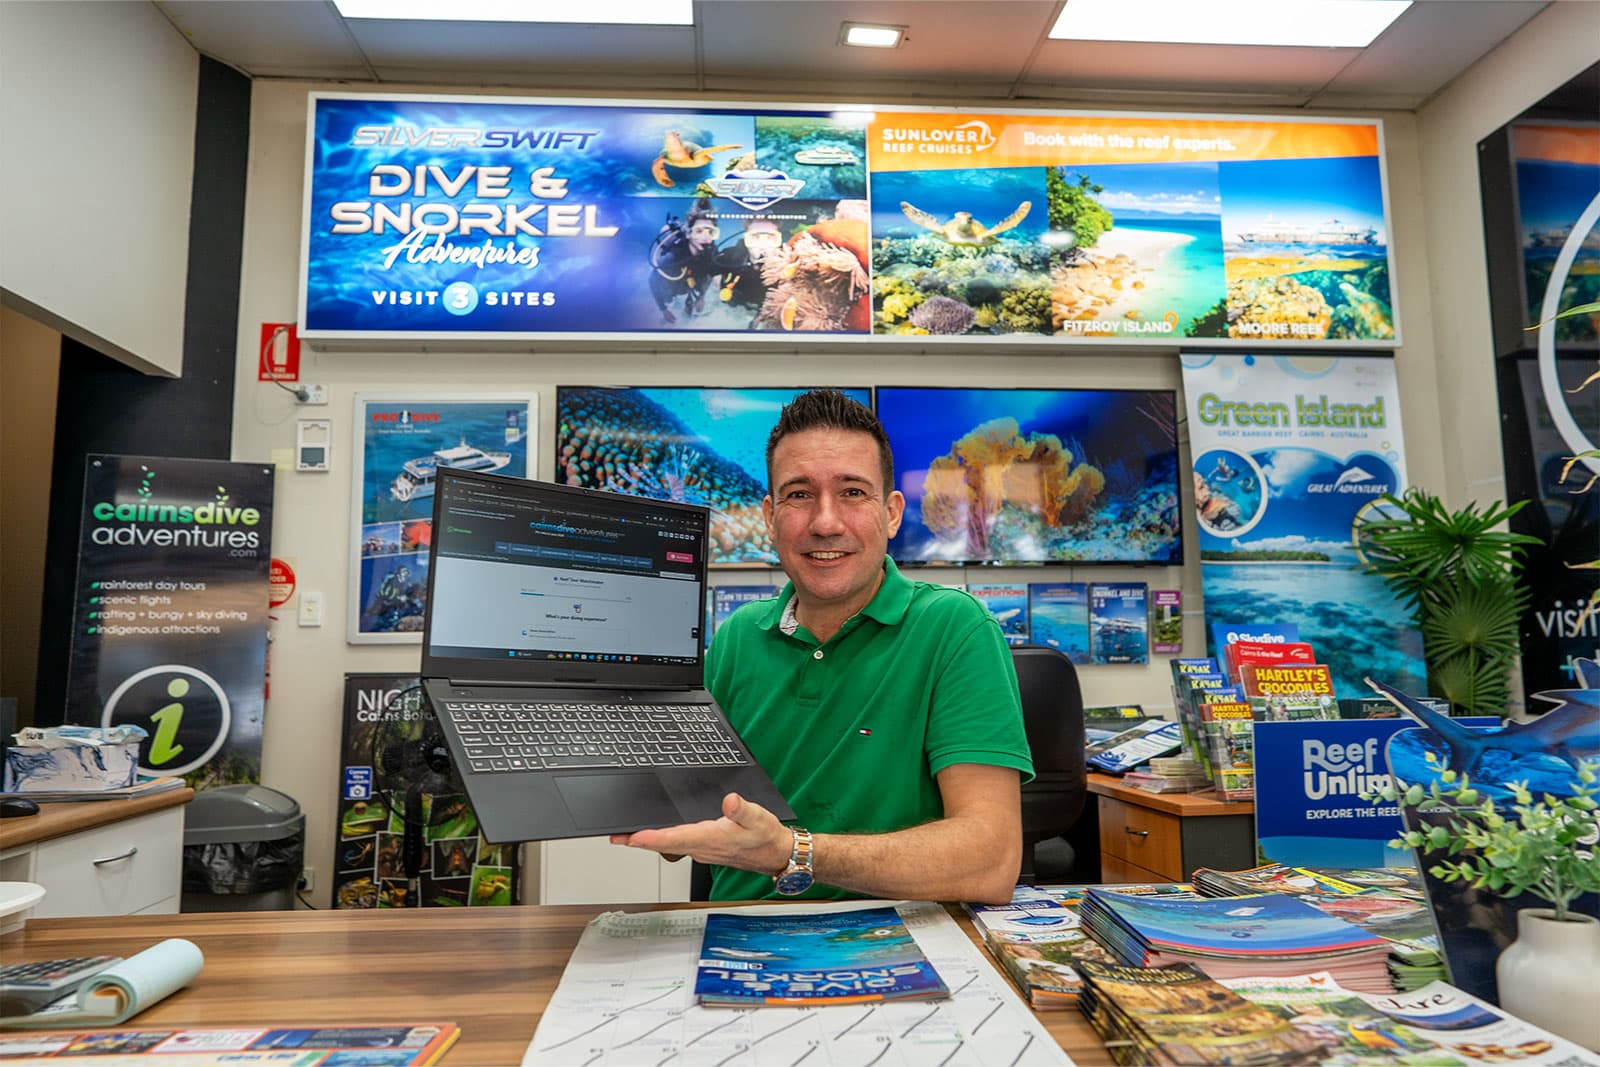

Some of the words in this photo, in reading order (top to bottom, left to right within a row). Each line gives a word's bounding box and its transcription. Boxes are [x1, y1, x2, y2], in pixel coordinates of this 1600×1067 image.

[882, 128, 977, 143] SUNLOVER
[1023, 131, 1065, 147] Book
[1067, 132, 1104, 148] with
[1107, 133, 1133, 148] the
[1136, 134, 1170, 149] reef
[1172, 135, 1237, 153] experts.
[883, 143, 913, 154] REEF
[915, 143, 973, 155] CRUISES
[369, 165, 512, 198] DIVE
[530, 167, 568, 197] &
[330, 202, 619, 238] SNORKEL
[382, 230, 540, 270] Adventures
[372, 291, 438, 306] VISIT
[450, 287, 470, 310] 3
[485, 291, 556, 306] SITES
[1063, 320, 1120, 333] FITZROY
[1122, 320, 1172, 334] ISLAND
[1238, 322, 1287, 335] MOORE
[1198, 393, 1290, 427] Green
[1295, 395, 1386, 428] Island
[1307, 483, 1333, 494] GREAT
[1337, 484, 1389, 494] ADVENTURES
[93, 502, 260, 525] cairnsdive
[92, 524, 259, 548] adventures
[227, 548, 257, 558] .com
[99, 580, 153, 590] rainforest
[155, 580, 178, 592] day
[179, 582, 206, 591] tours
[98, 595, 137, 606] scenic
[140, 596, 172, 607] flights
[97, 609, 136, 621] rafting
[147, 610, 184, 622] bungy
[196, 610, 212, 621] sky
[215, 611, 248, 622] diving
[96, 624, 160, 635] indigenous
[161, 625, 221, 635] attractions
[1255, 669, 1327, 682] HARTLEY'S
[1258, 682, 1330, 694] CROCODILES
[1302, 738, 1378, 773] Reef
[1306, 809, 1354, 820] EXPLORE
[1355, 808, 1376, 818] THE
[704, 965, 921, 982] SNORKEL
[743, 981, 771, 992] &
[787, 977, 897, 992] DIVE
